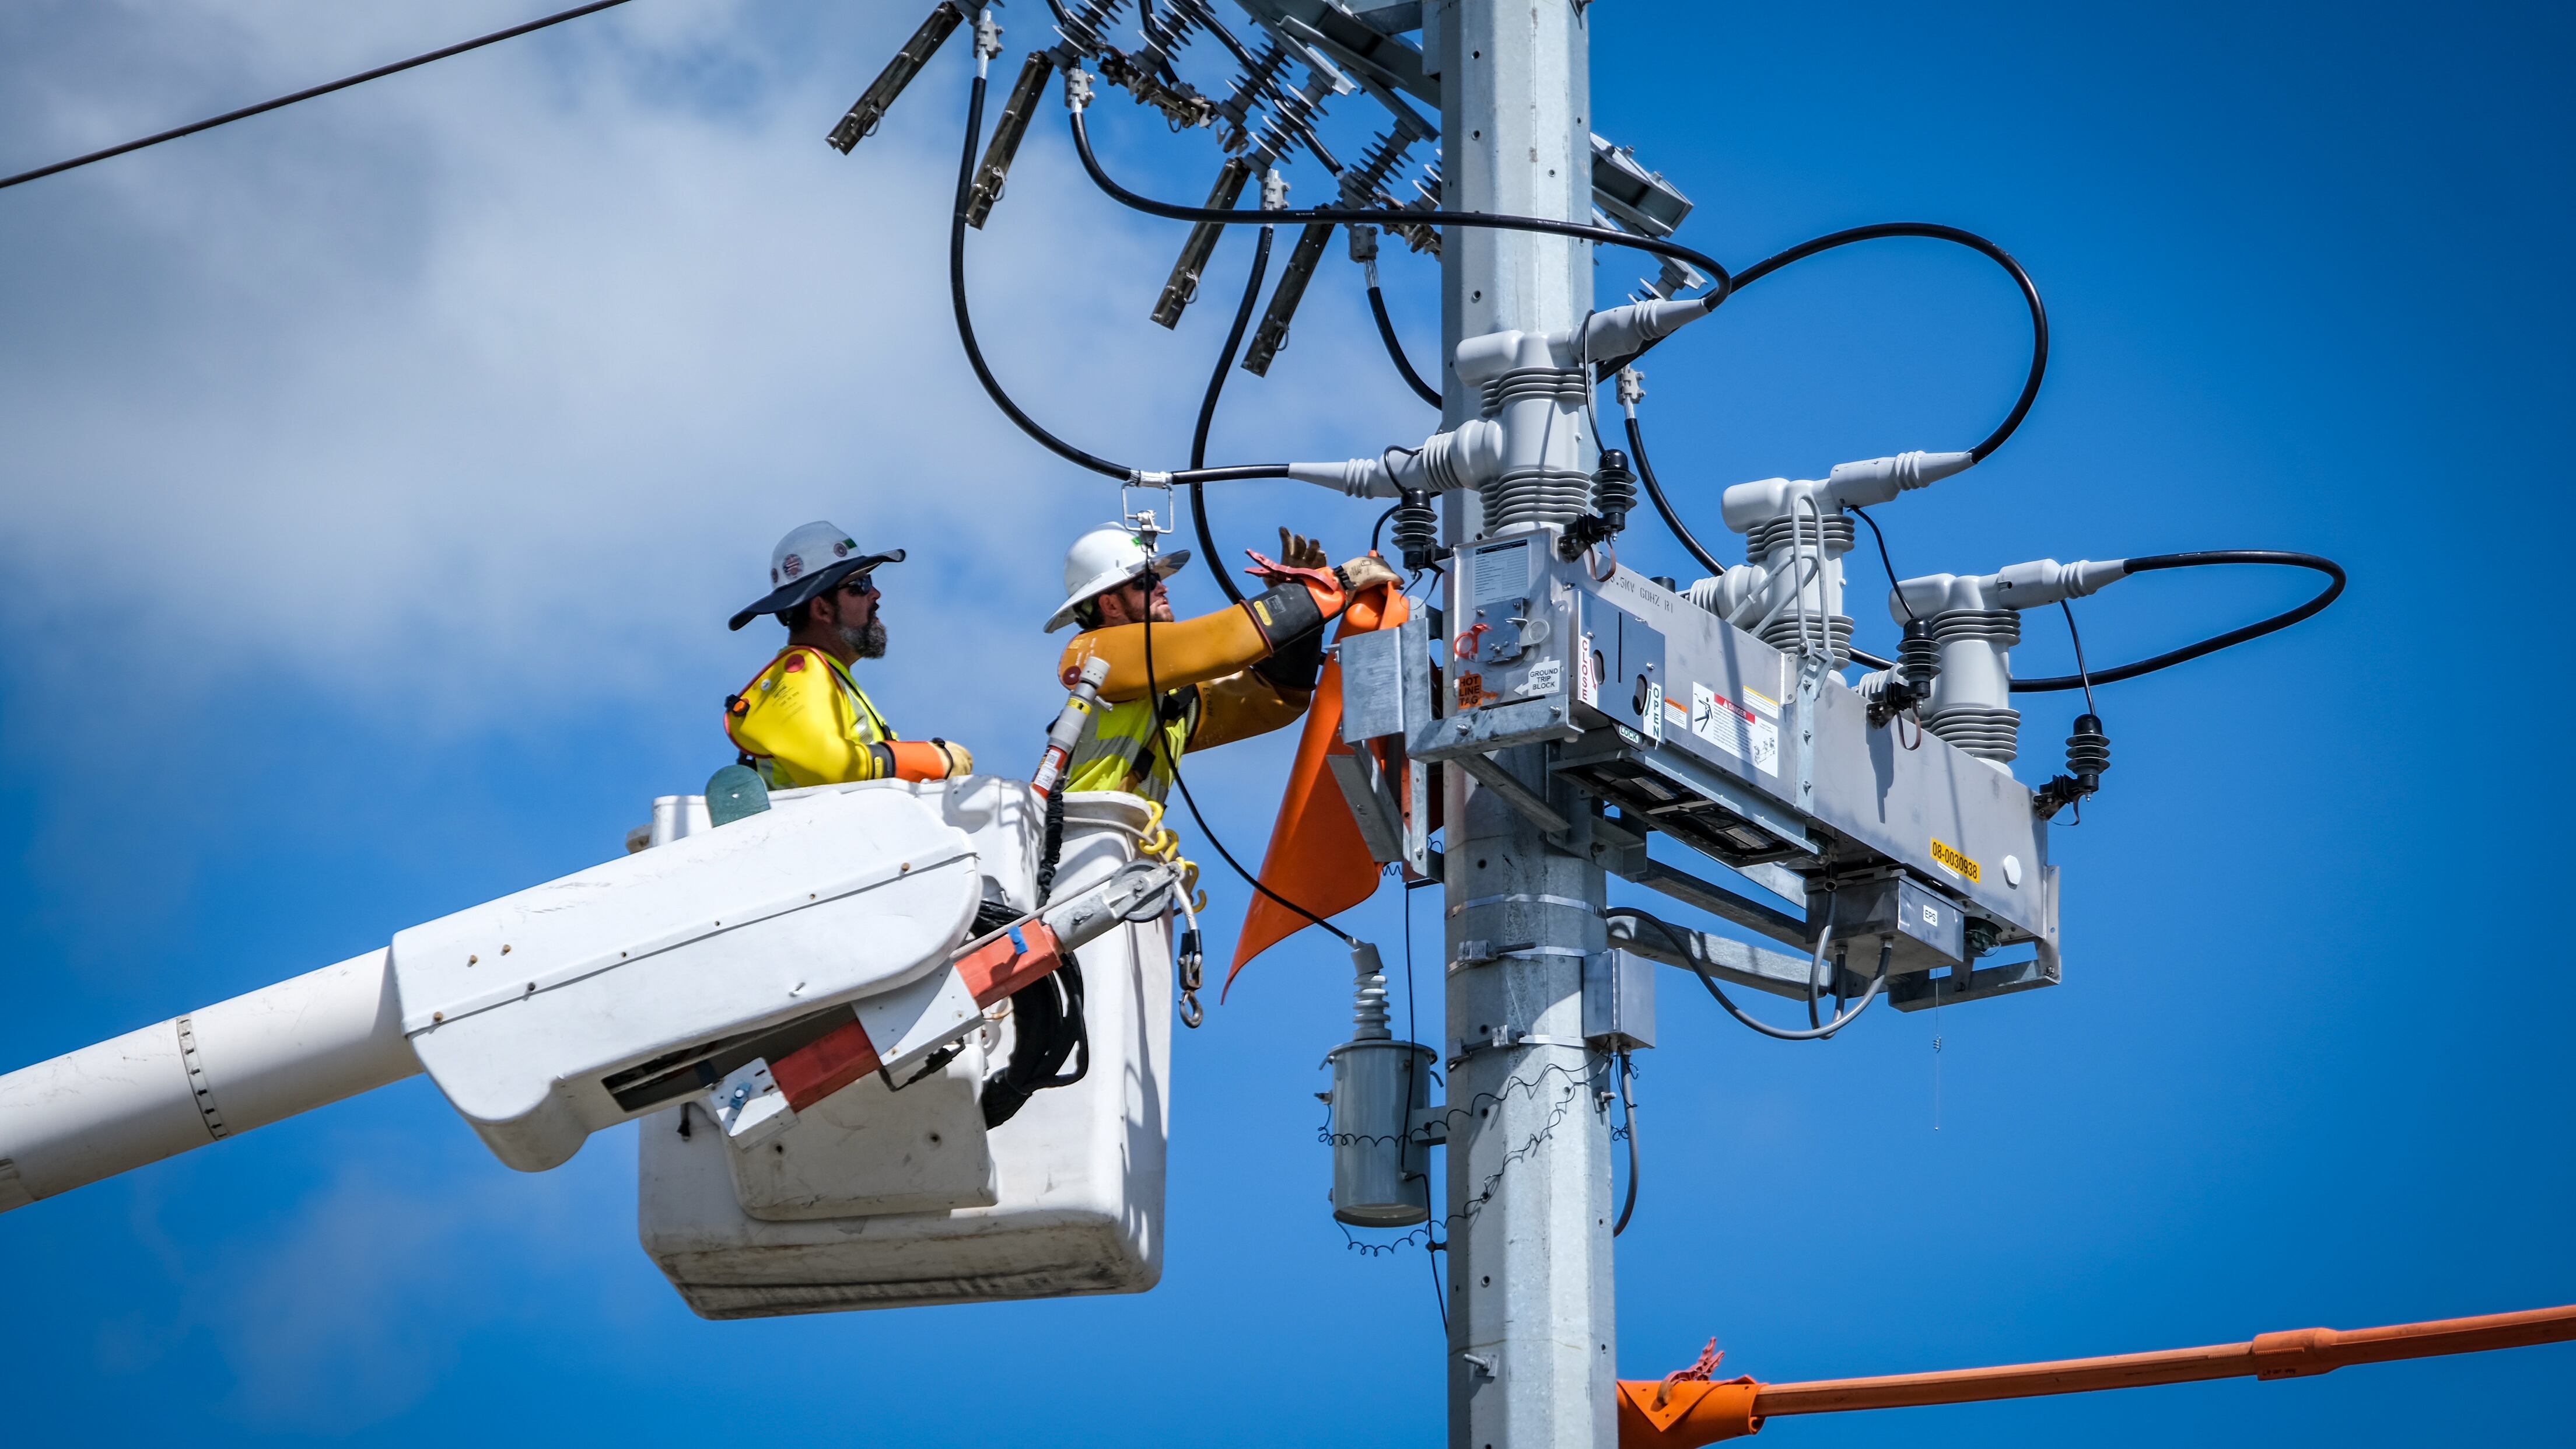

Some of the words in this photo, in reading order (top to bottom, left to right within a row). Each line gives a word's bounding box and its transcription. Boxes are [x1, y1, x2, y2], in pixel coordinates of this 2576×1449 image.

[1530, 668, 1558, 677] GROUND
[1460, 676, 1479, 687] HOT
[1532, 681, 1555, 690] BLOCK
[1460, 685, 1480, 696] LINE
[1460, 695, 1478, 706] TAG
[1728, 703, 1746, 718] DANGER
[1620, 726, 1639, 741] LOCK
[1933, 842, 1978, 879] 08-0030938
[1925, 910, 1936, 922] EPS
